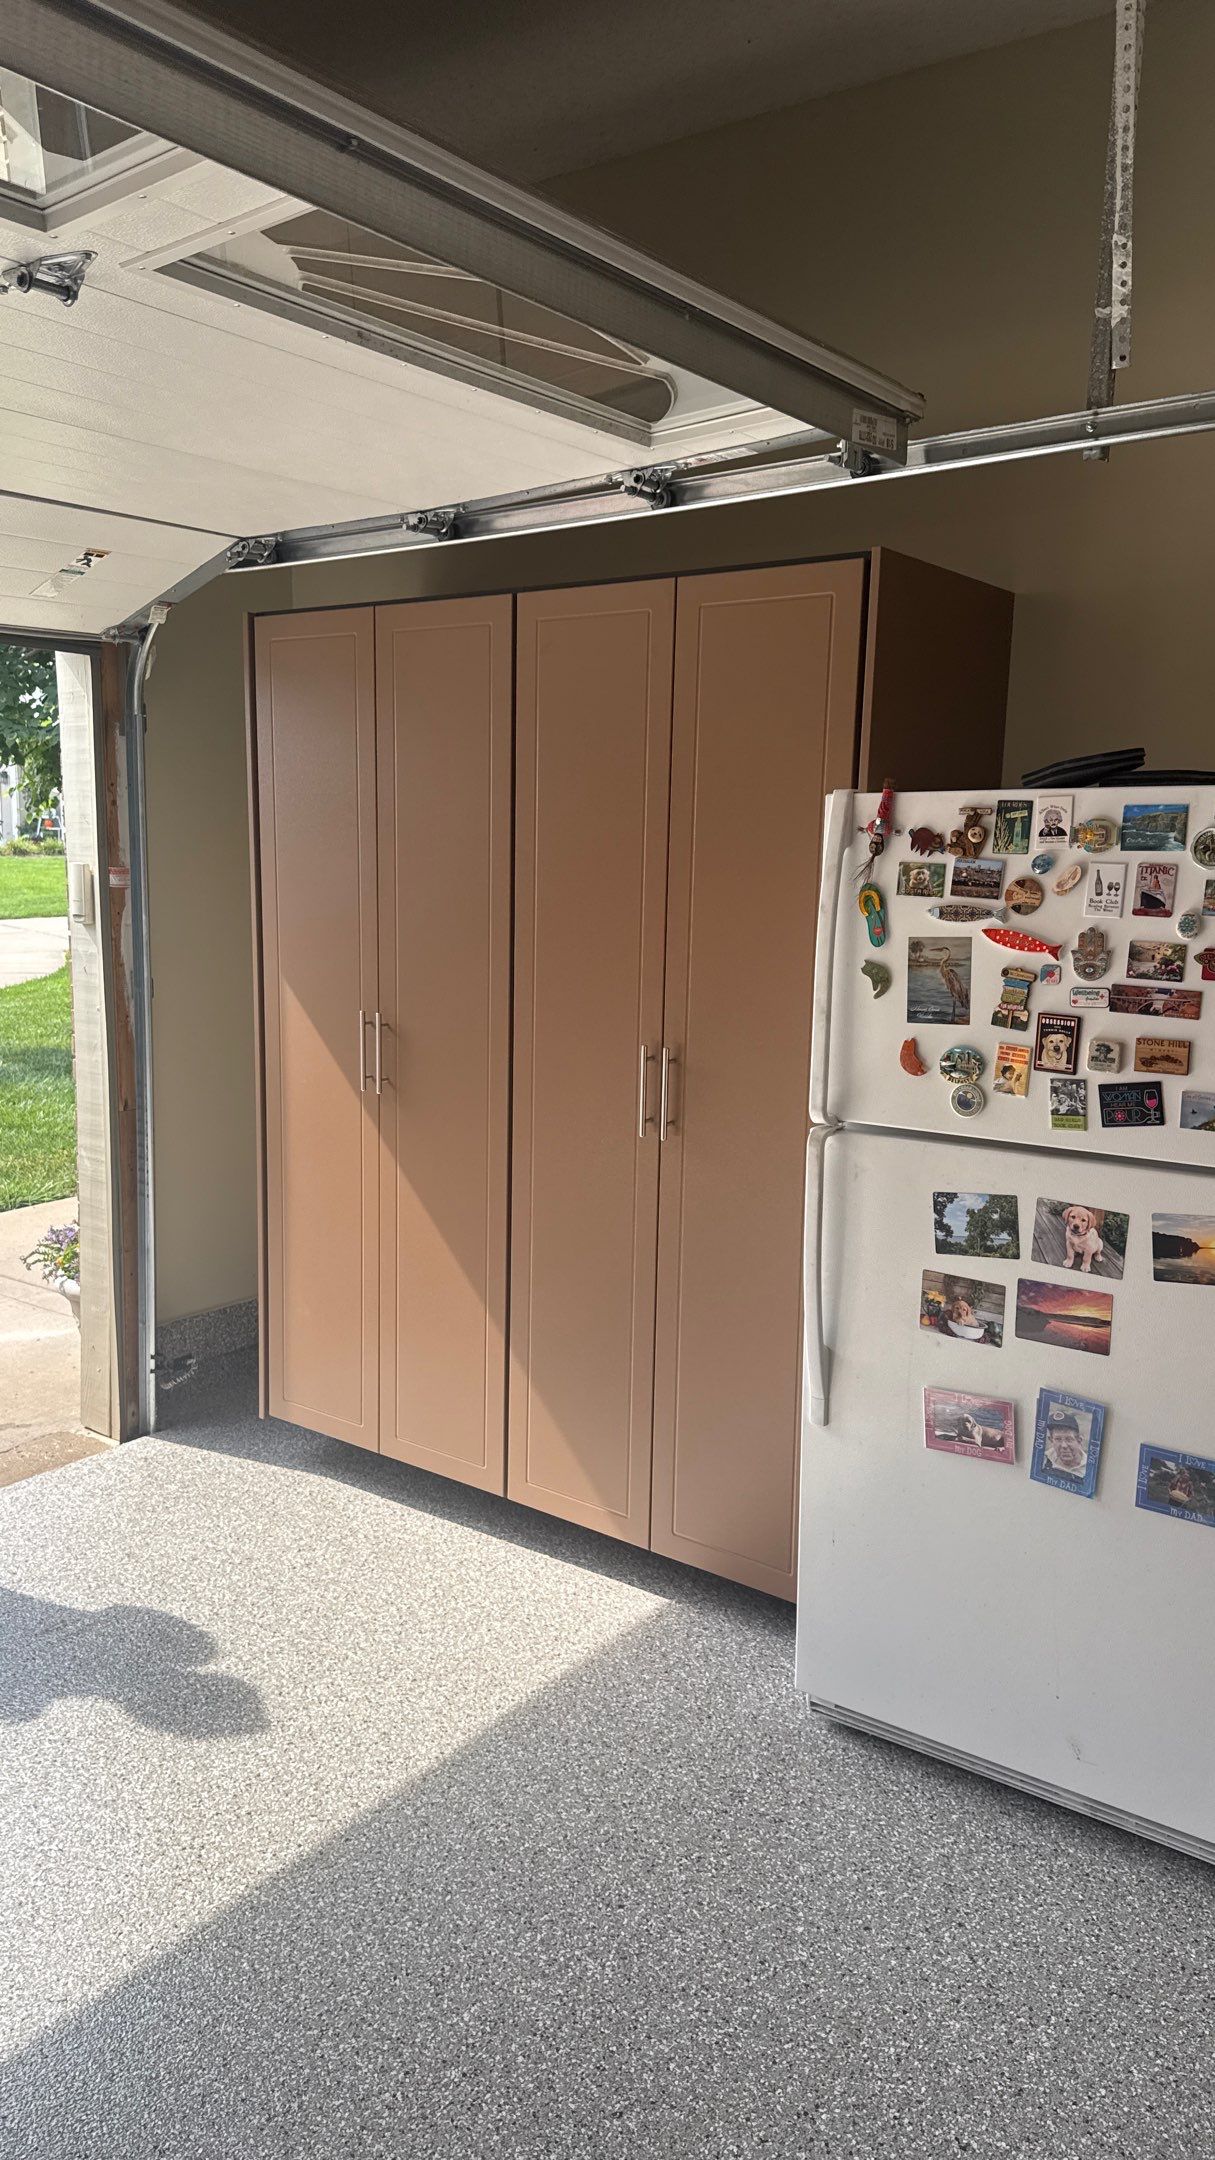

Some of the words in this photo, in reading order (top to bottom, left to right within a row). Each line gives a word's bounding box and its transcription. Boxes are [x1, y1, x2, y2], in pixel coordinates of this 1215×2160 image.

[1139, 865, 1174, 876] TITANIC
[1042, 1018, 1075, 1027] OBSESSION
[1137, 1039, 1166, 1047] STONE
[1102, 1091, 1142, 1101] WOMAN
[1106, 1108, 1142, 1122] POUR
[1035, 1432, 1044, 1449] DAD
[966, 1448, 982, 1457] DOG
[1178, 1453, 1183, 1463] I
[1059, 1480, 1077, 1492] DAD
[1185, 1510, 1204, 1521] DAD
